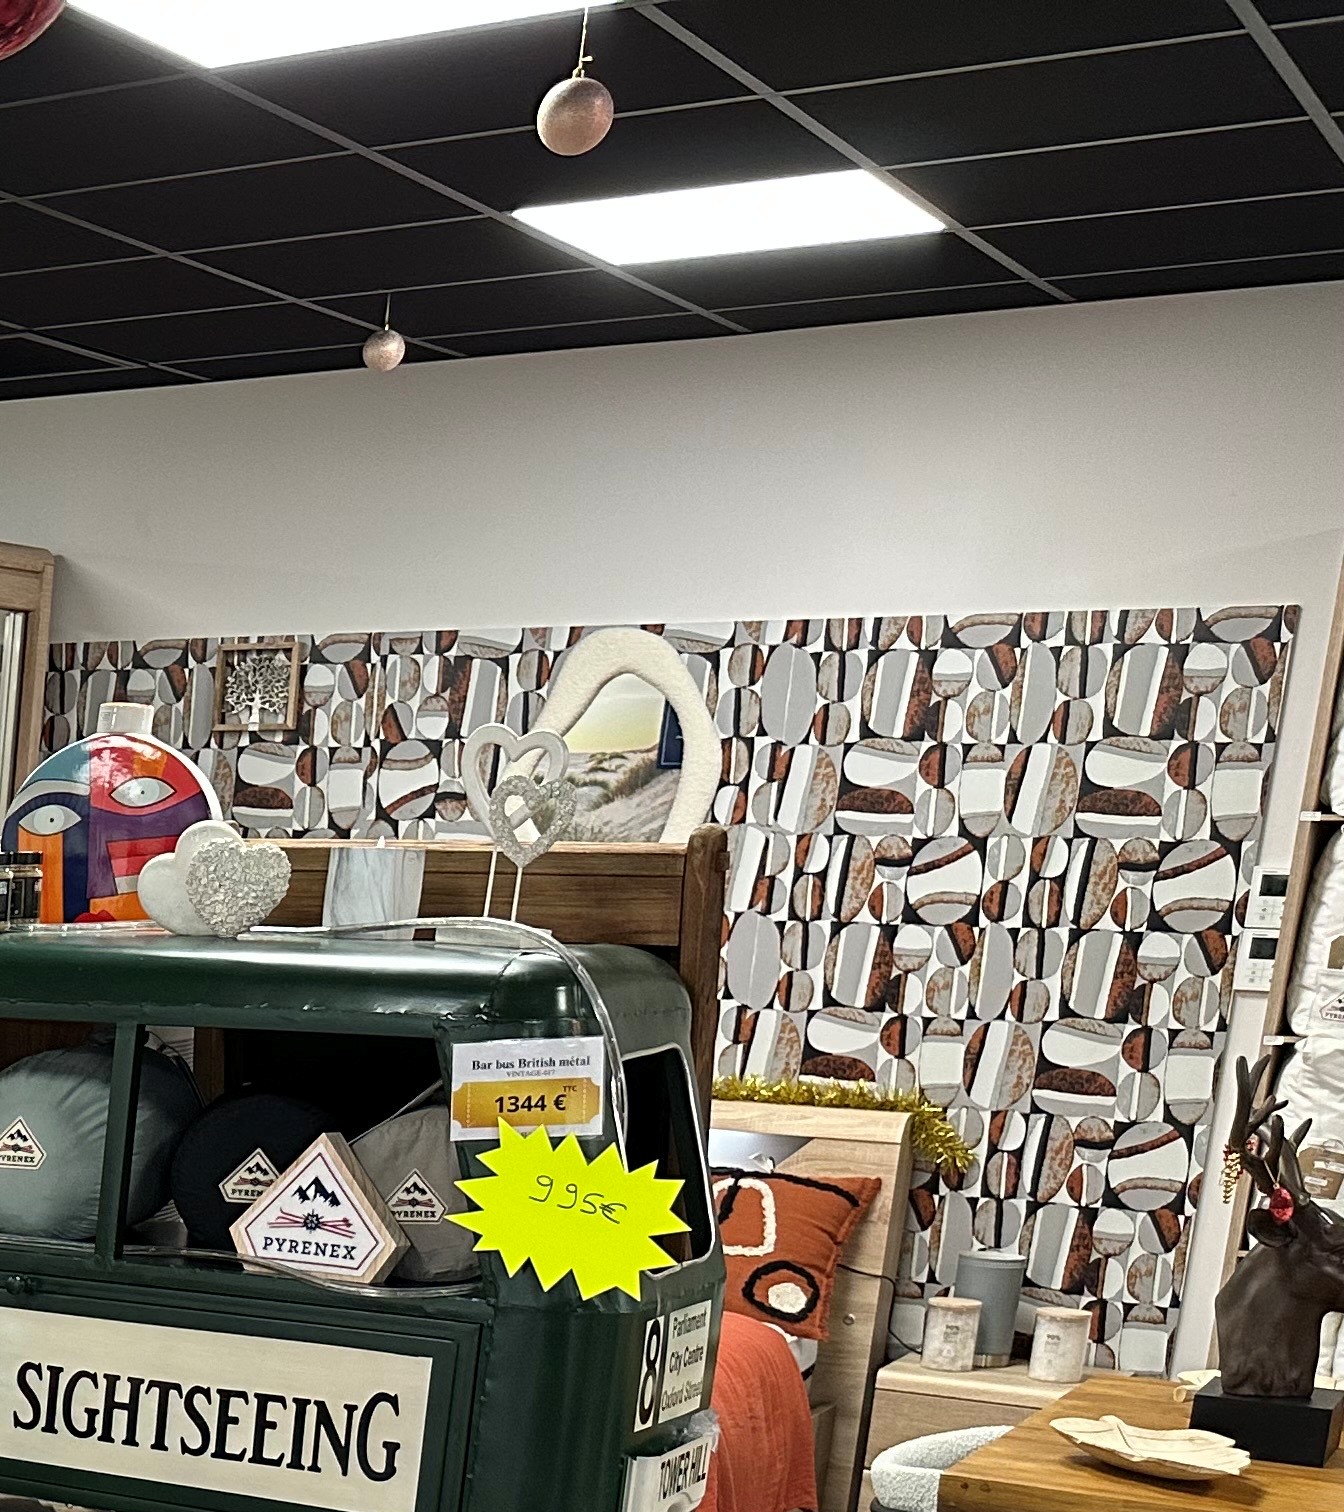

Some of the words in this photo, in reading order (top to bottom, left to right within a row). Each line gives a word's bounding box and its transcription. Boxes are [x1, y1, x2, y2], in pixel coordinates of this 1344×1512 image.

[472, 1060, 493, 1071] Bar
[495, 1059, 514, 1070] bus
[518, 1057, 556, 1068] British
[559, 1055, 590, 1067] métal
[495, 1094, 547, 1113] 1344
[553, 1094, 567, 1111] €
[528, 1174, 628, 1225] 995€
[263, 1236, 357, 1261] PYRENEX
[672, 1306, 707, 1340] Parliament
[639, 1318, 661, 1425] 8
[669, 1350, 682, 1376] City
[683, 1345, 704, 1370] Centre
[661, 1383, 684, 1411] Oxford
[12, 1360, 401, 1482] SIGHTSEEING
[661, 1449, 691, 1499] TOWER
[690, 1442, 709, 1487] HILL
